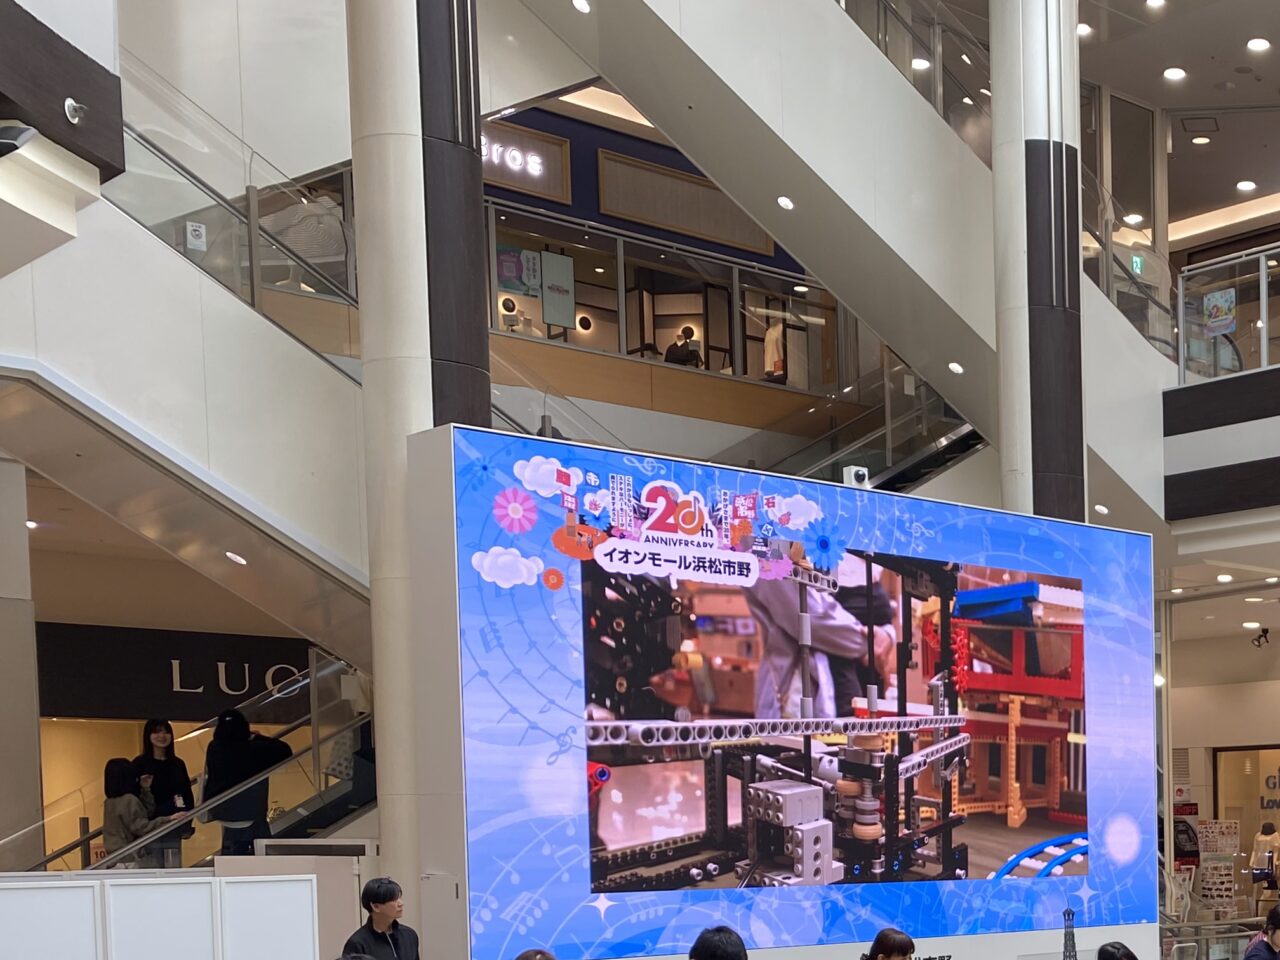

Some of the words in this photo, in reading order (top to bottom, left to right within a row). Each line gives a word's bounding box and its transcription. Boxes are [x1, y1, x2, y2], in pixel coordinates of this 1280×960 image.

[644, 535, 714, 549] ANNIVERSARY
[603, 547, 751, 577] イオンモール浜松市野
